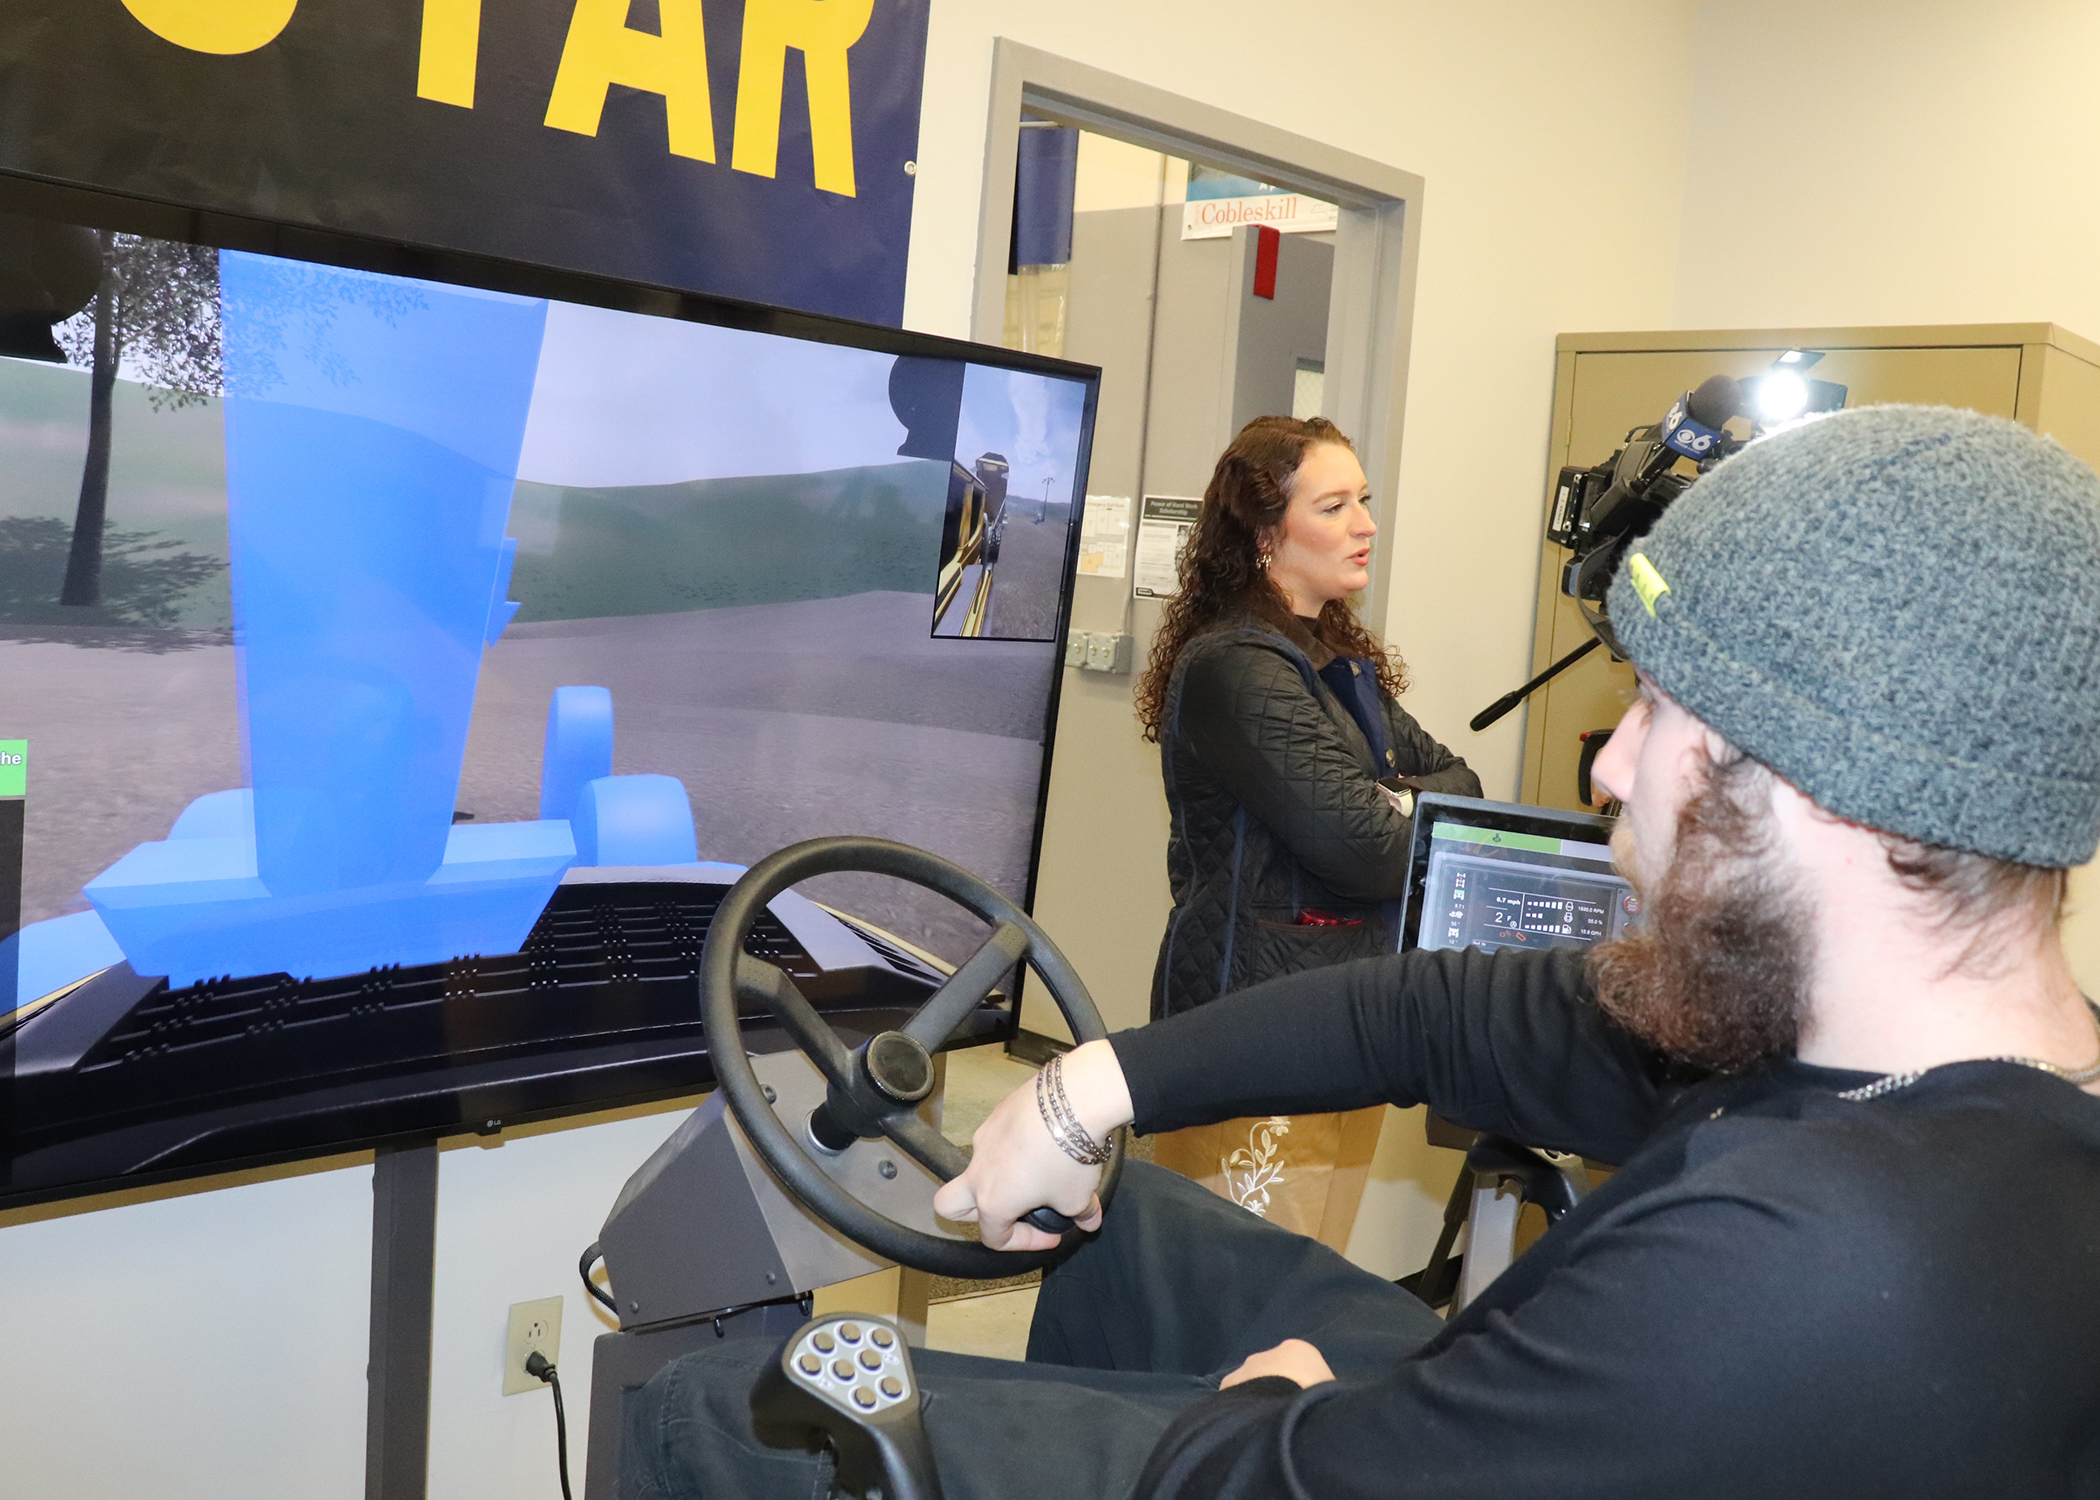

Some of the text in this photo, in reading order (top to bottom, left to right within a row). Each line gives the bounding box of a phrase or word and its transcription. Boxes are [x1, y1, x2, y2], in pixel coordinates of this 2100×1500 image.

[1201, 197, 1298, 225] Cobleskill
[1669, 411, 1683, 430] 6
[1691, 434, 1713, 451] 6
[1494, 912, 1503, 923] 2
